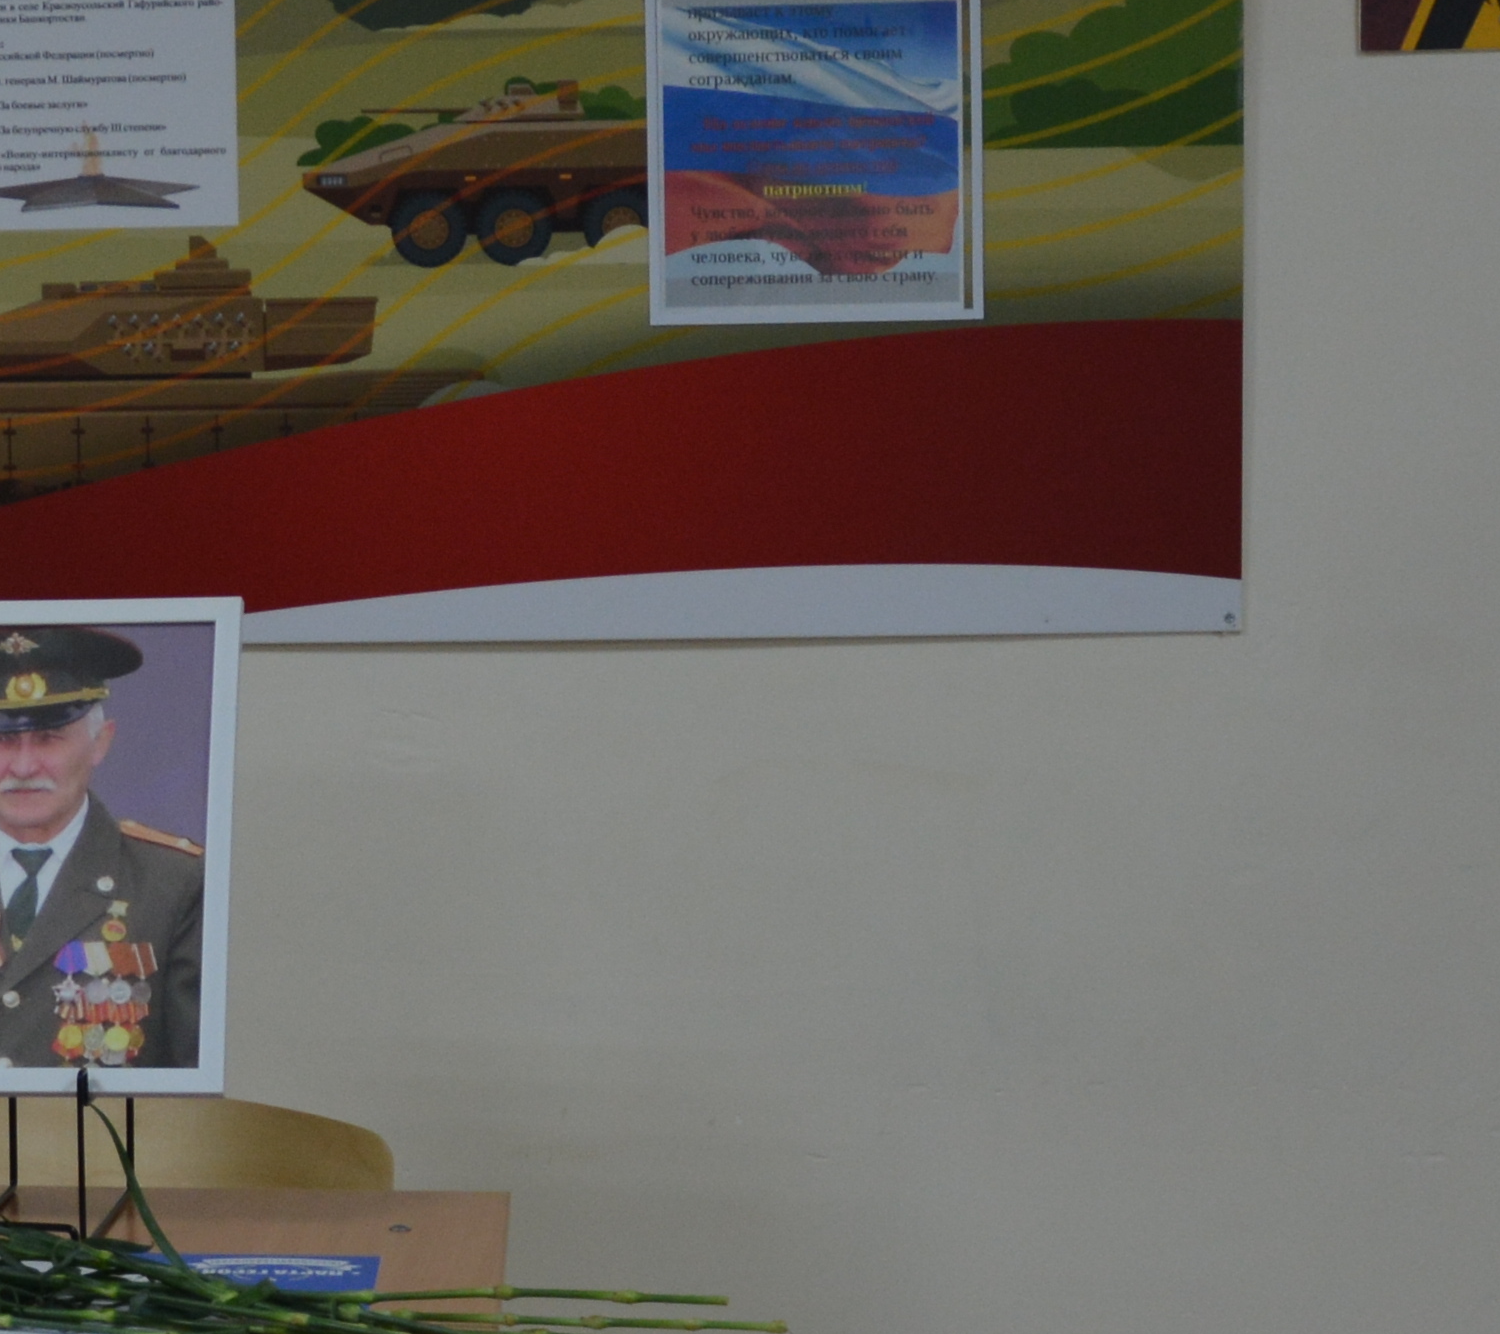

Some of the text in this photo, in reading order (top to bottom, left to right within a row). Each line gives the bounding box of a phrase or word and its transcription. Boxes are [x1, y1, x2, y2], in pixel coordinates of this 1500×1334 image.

[688, 24, 905, 44] окружающих, кто помогает
[43, 50, 95, 60] Федерации
[688, 48, 903, 66] совершенствоваться своим
[4, 77, 46, 86] генерала
[61, 74, 127, 85] Шаймуратова
[688, 72, 797, 88] согражданам.
[762, 181, 868, 198] патриотизм!
[691, 250, 767, 265] человека,
[691, 271, 938, 288] сопереживания за свою страну.
